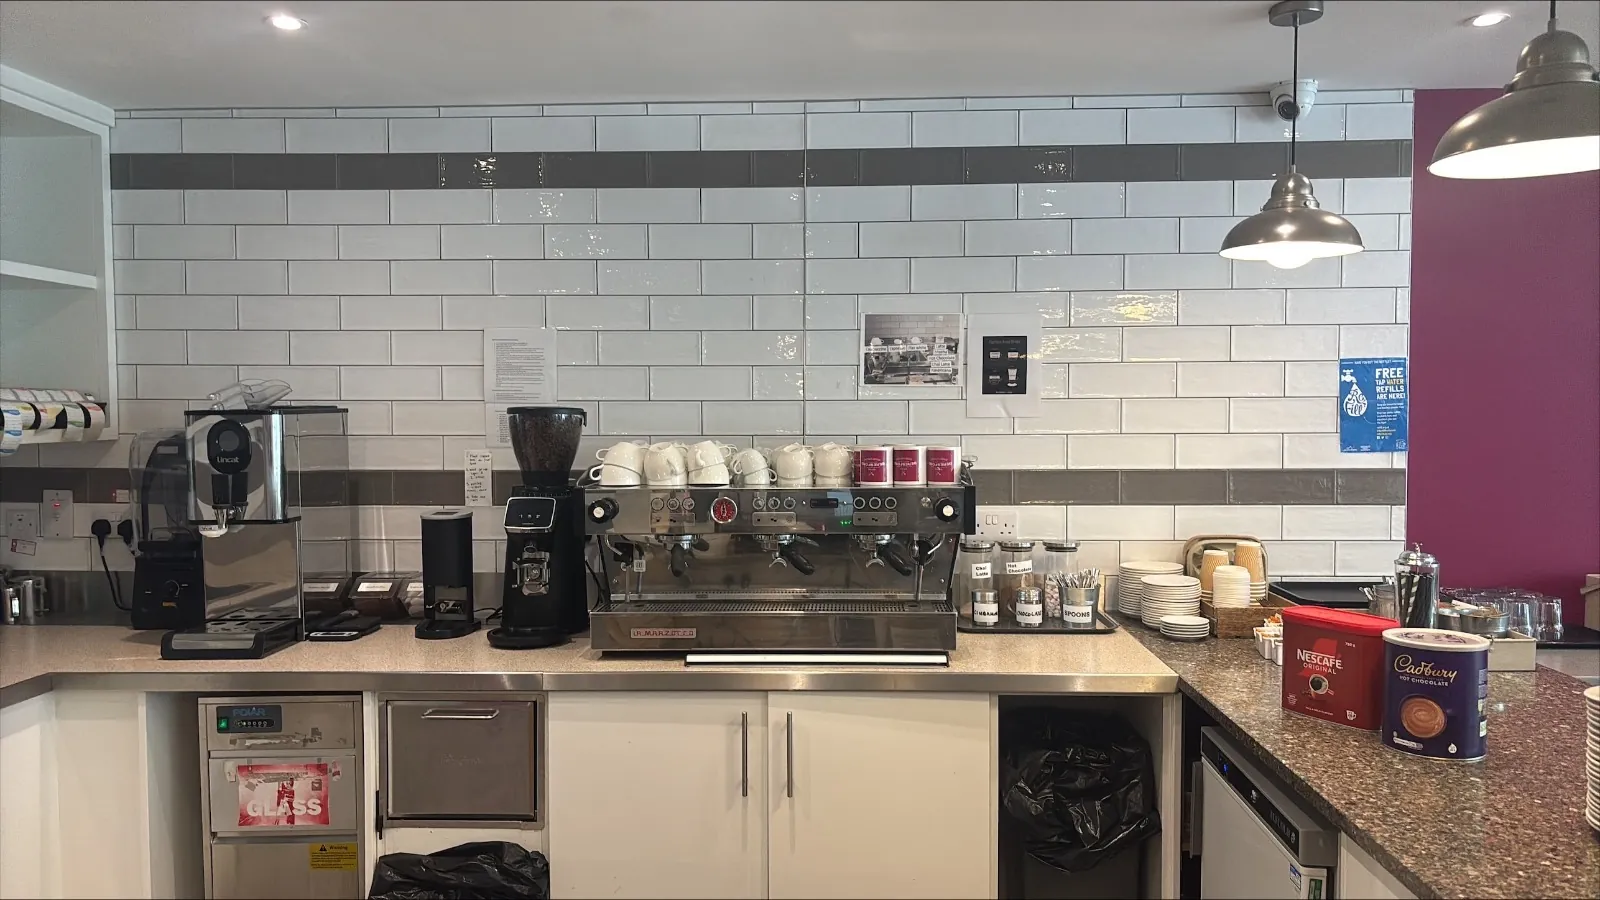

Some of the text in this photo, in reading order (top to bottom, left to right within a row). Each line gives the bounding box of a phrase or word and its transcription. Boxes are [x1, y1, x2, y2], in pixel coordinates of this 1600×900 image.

[1376, 368, 1403, 378] FREE
[1303, 663, 1336, 674] ORIGINAL
[1394, 654, 1457, 683] Cadbury
[1412, 678, 1448, 686] CHOCOLATE
[246, 799, 322, 817] GLASS
